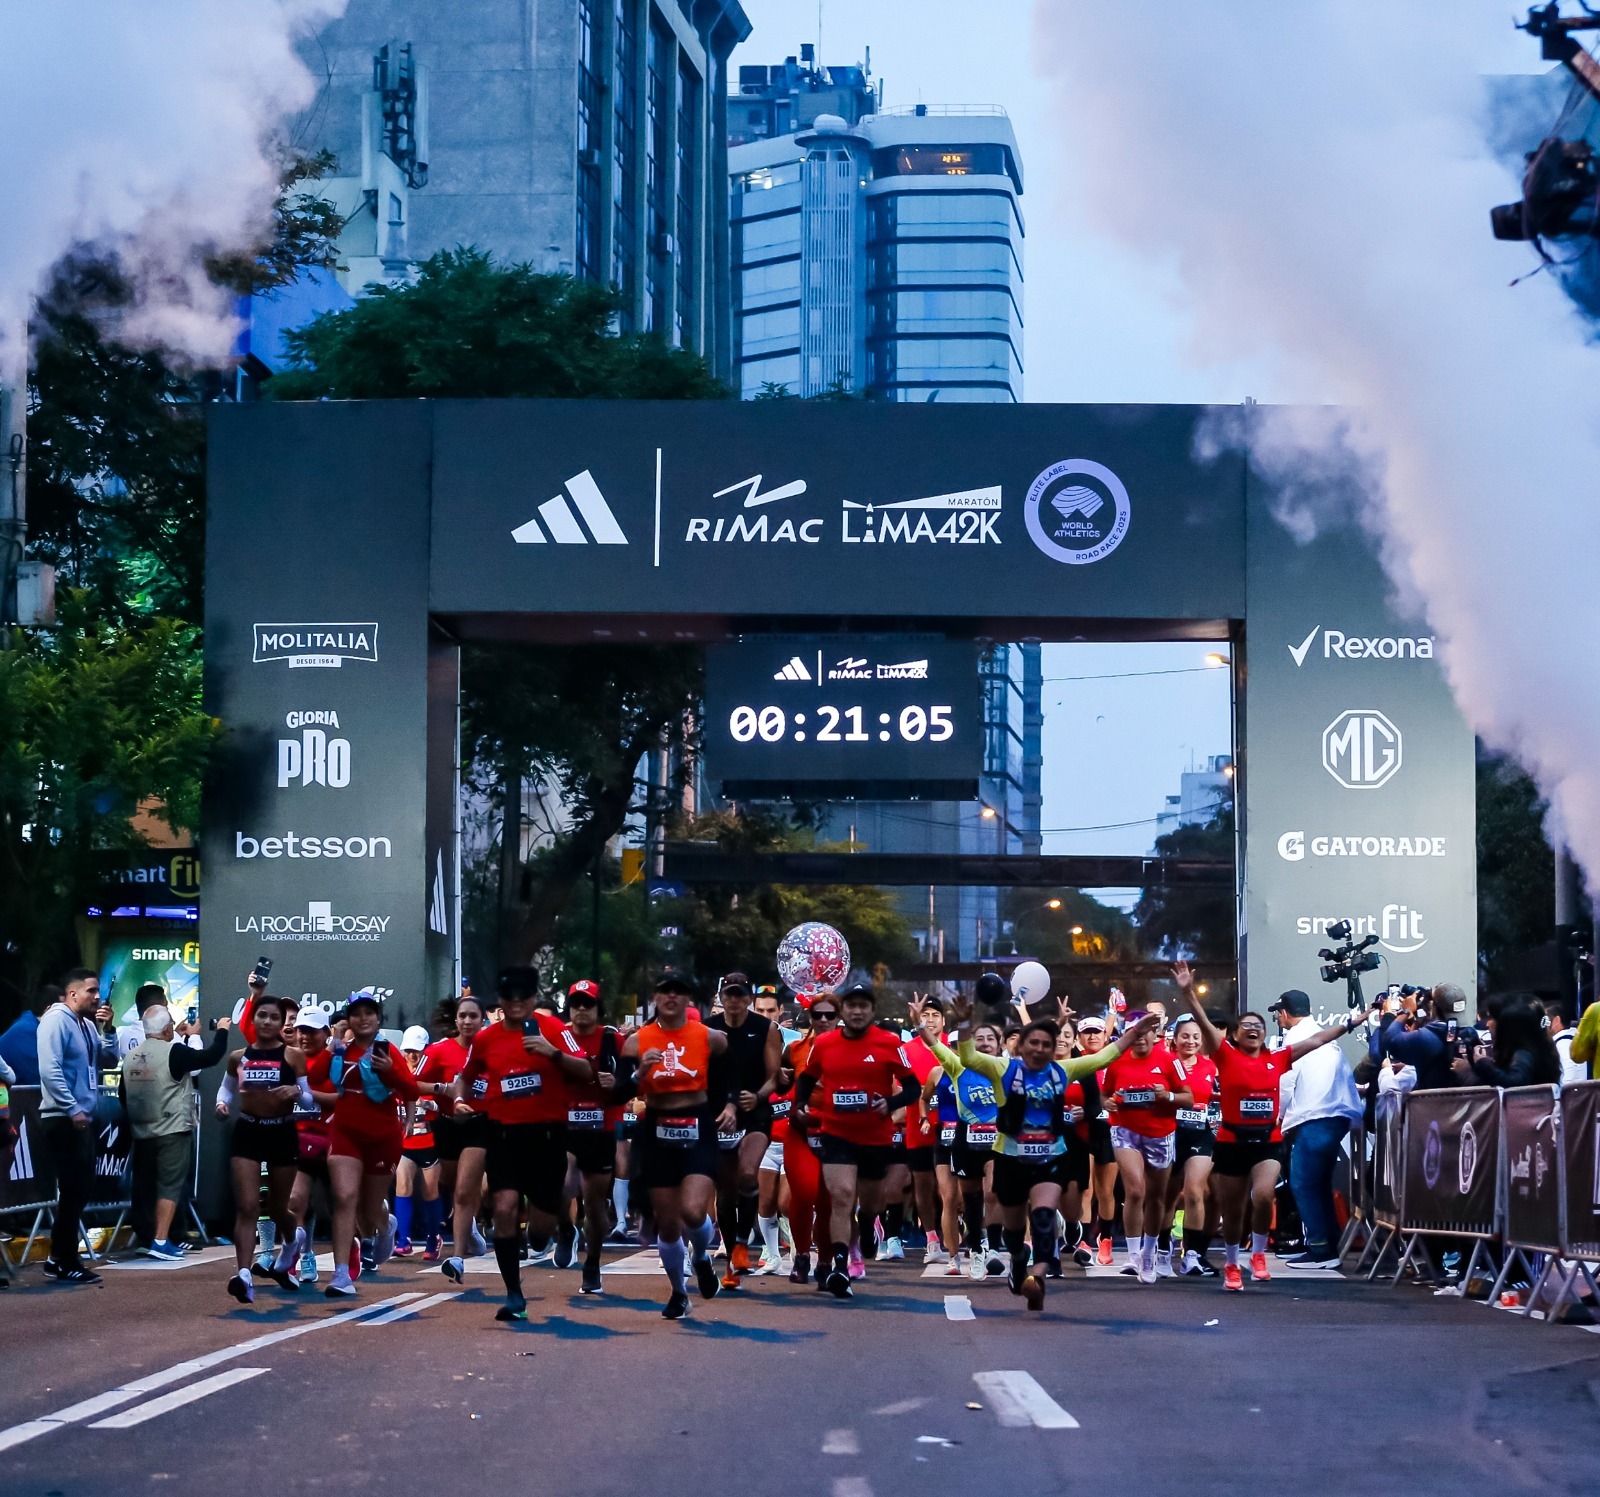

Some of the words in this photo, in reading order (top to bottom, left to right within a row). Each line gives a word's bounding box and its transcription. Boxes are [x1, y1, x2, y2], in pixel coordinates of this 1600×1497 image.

[1029, 481, 1045, 502] ELITE
[1043, 464, 1069, 481] LABEL
[685, 515, 824, 543] RIMAC
[1061, 521, 1094, 530] WORLD
[1053, 529, 1101, 538] ATHLETICS
[1075, 549, 1100, 561] ROAD
[1100, 533, 1119, 553] RACE
[1115, 510, 1127, 534] 2025
[261, 631, 370, 651] MOLITALIA
[1323, 629, 1433, 659] Rexona
[828, 668, 873, 679] RIMAC
[285, 710, 340, 729] GLORIA
[729, 705, 954, 742] 00:21:05
[1330, 717, 1395, 782] MG
[235, 831, 392, 859] betsson
[1311, 836, 1446, 857] GATORADE
[235, 916, 259, 933] LA
[331, 916, 391, 933] POSAY
[1381, 903, 1425, 939] fit
[261, 933, 313, 942] LABORATOIRE
[313, 933, 381, 943] DERMATOLOGIQUE
[132, 947, 182, 961] smart
[246, 1071, 276, 1080] 11212
[507, 1077, 535, 1089] 9285
[835, 1095, 864, 1104] 13515
[1243, 1101, 1271, 1111] 12684
[573, 1111, 598, 1121] 9286
[1181, 1111, 1202, 1120] 8326
[662, 1128, 690, 1139] 7640
[1024, 1144, 1050, 1154] 9106
